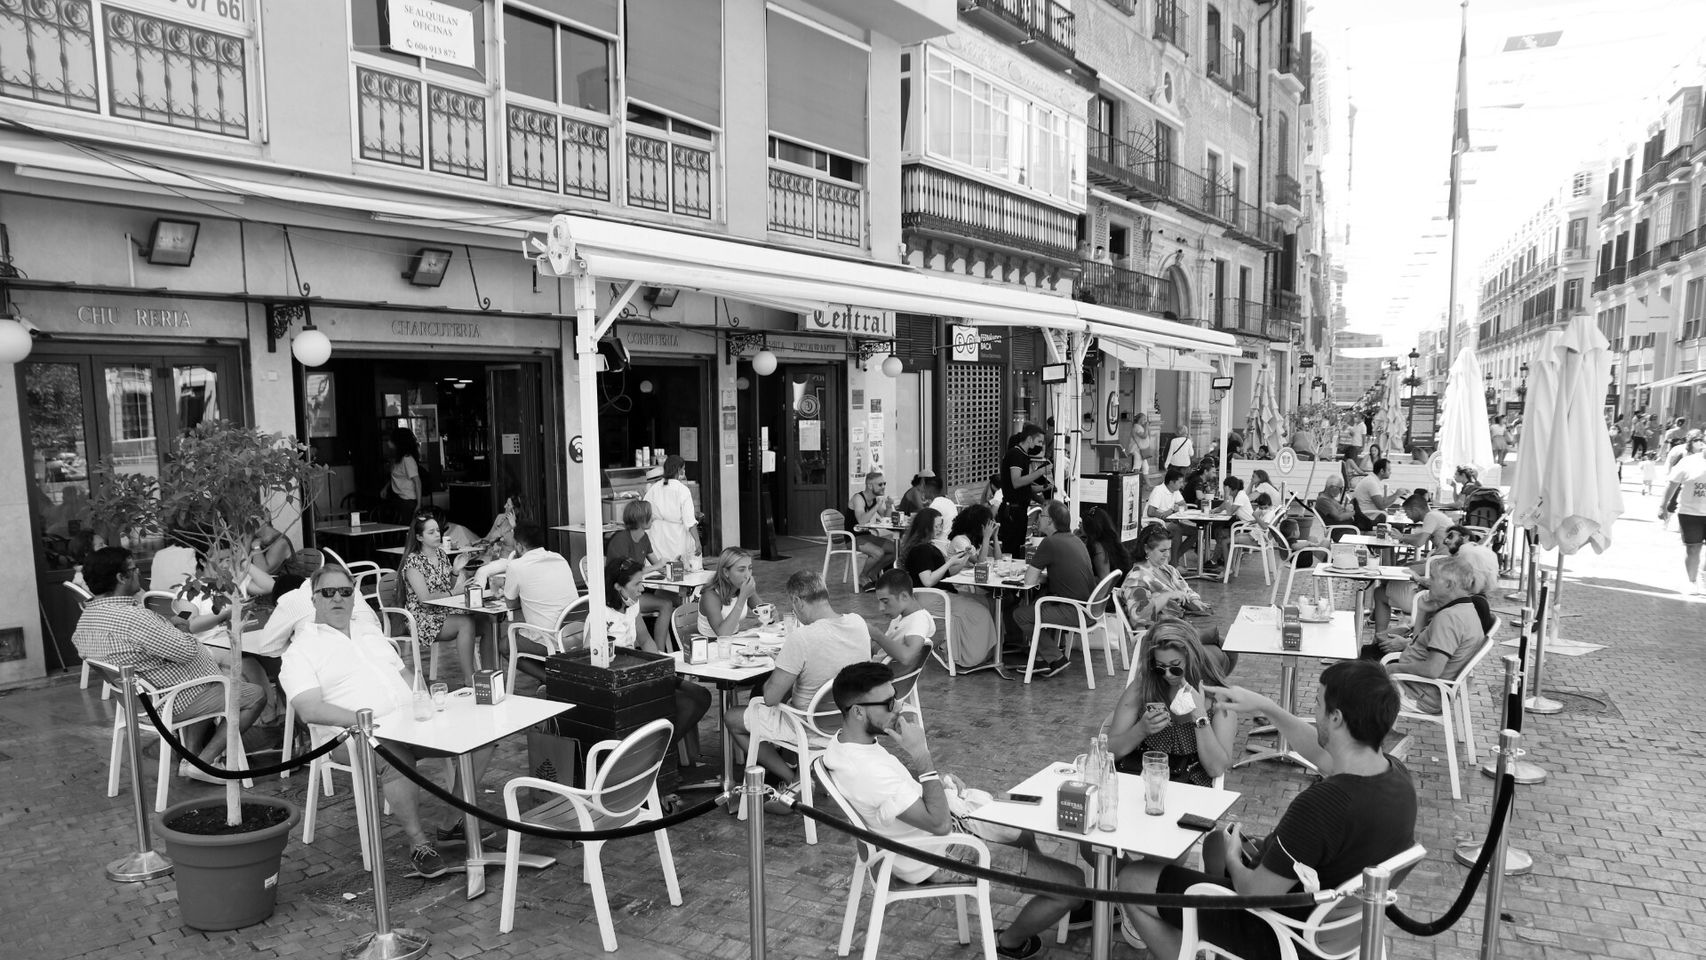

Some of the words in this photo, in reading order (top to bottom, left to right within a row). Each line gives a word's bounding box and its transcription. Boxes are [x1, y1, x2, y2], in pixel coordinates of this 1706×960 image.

[404, 4, 414, 14] SE
[415, 8, 459, 26] ALQUILAN
[412, 19, 453, 37] OFICINAS
[414, 42, 427, 51] 606
[443, 47, 456, 58] 872
[77, 305, 120, 325] CHU
[135, 308, 192, 328] RERIA
[813, 303, 888, 334] Central
